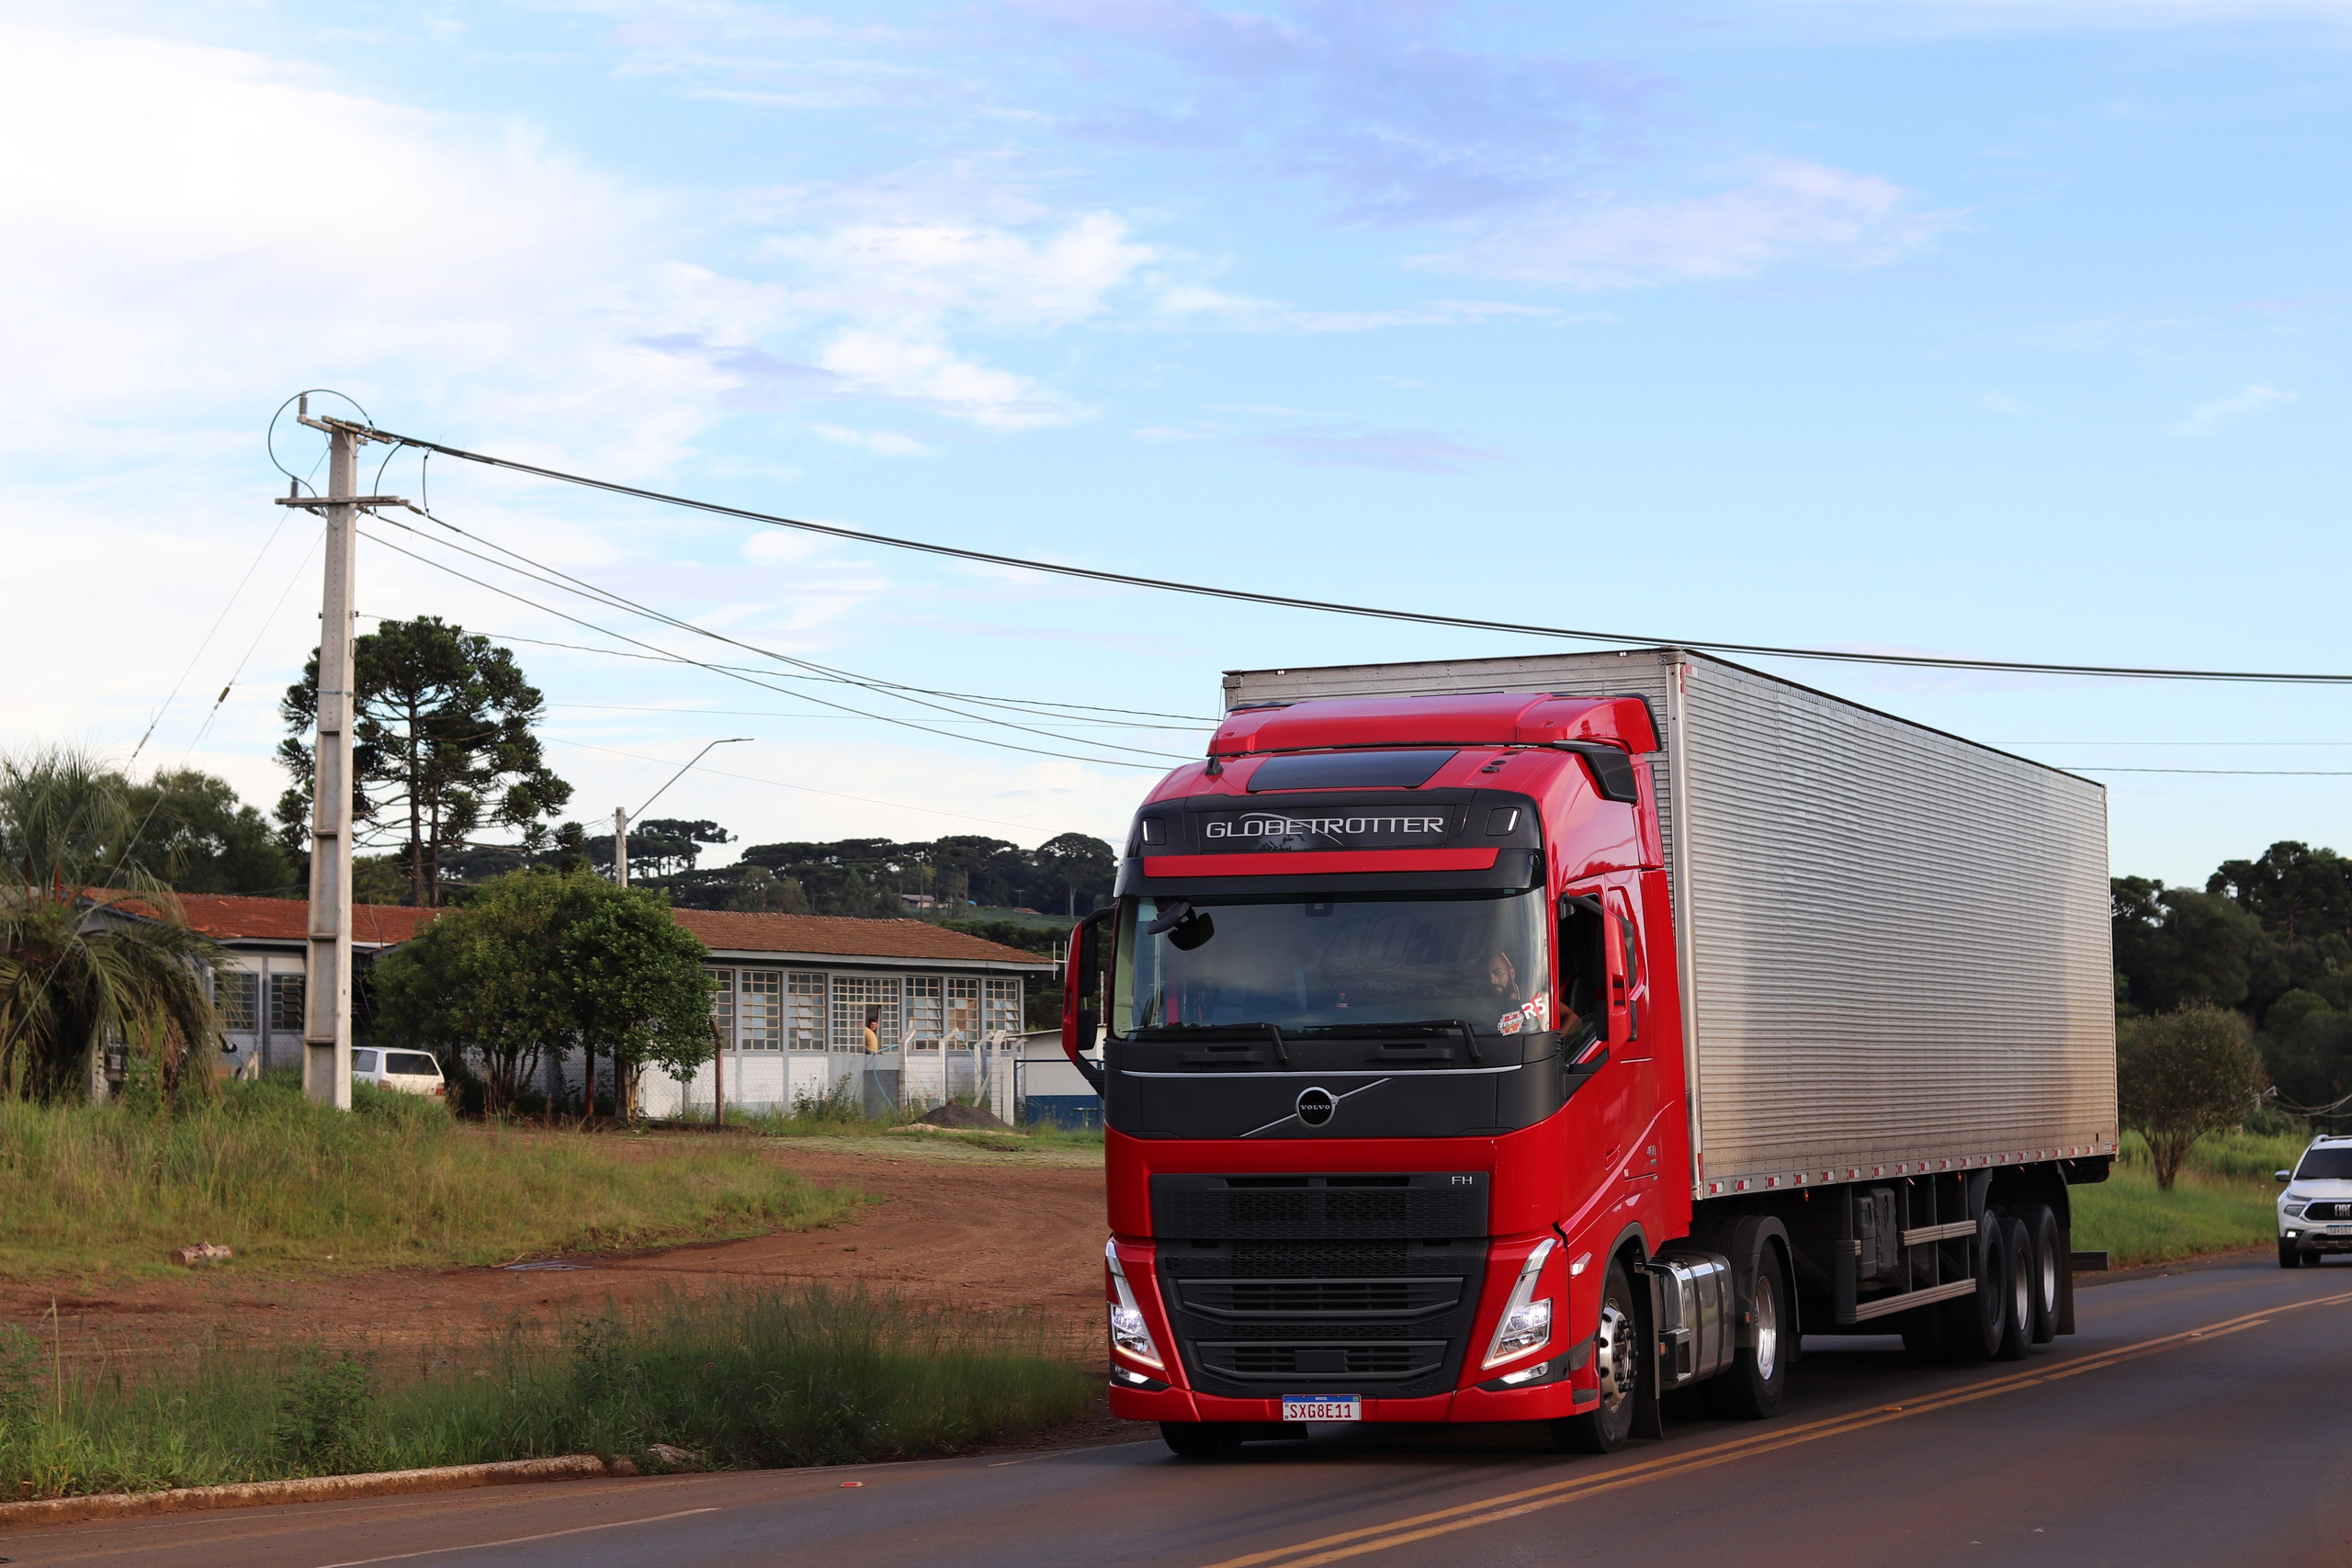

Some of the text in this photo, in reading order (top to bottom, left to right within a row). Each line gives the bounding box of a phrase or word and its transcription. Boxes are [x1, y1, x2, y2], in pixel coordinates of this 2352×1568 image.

[1205, 817, 1444, 839] GLOBETROTTER
[1521, 998, 1547, 1020] R5
[1452, 1176, 1473, 1185] FH
[2335, 1204, 2351, 1217] FIAT
[1290, 1404, 1351, 1418] SXG8E11
